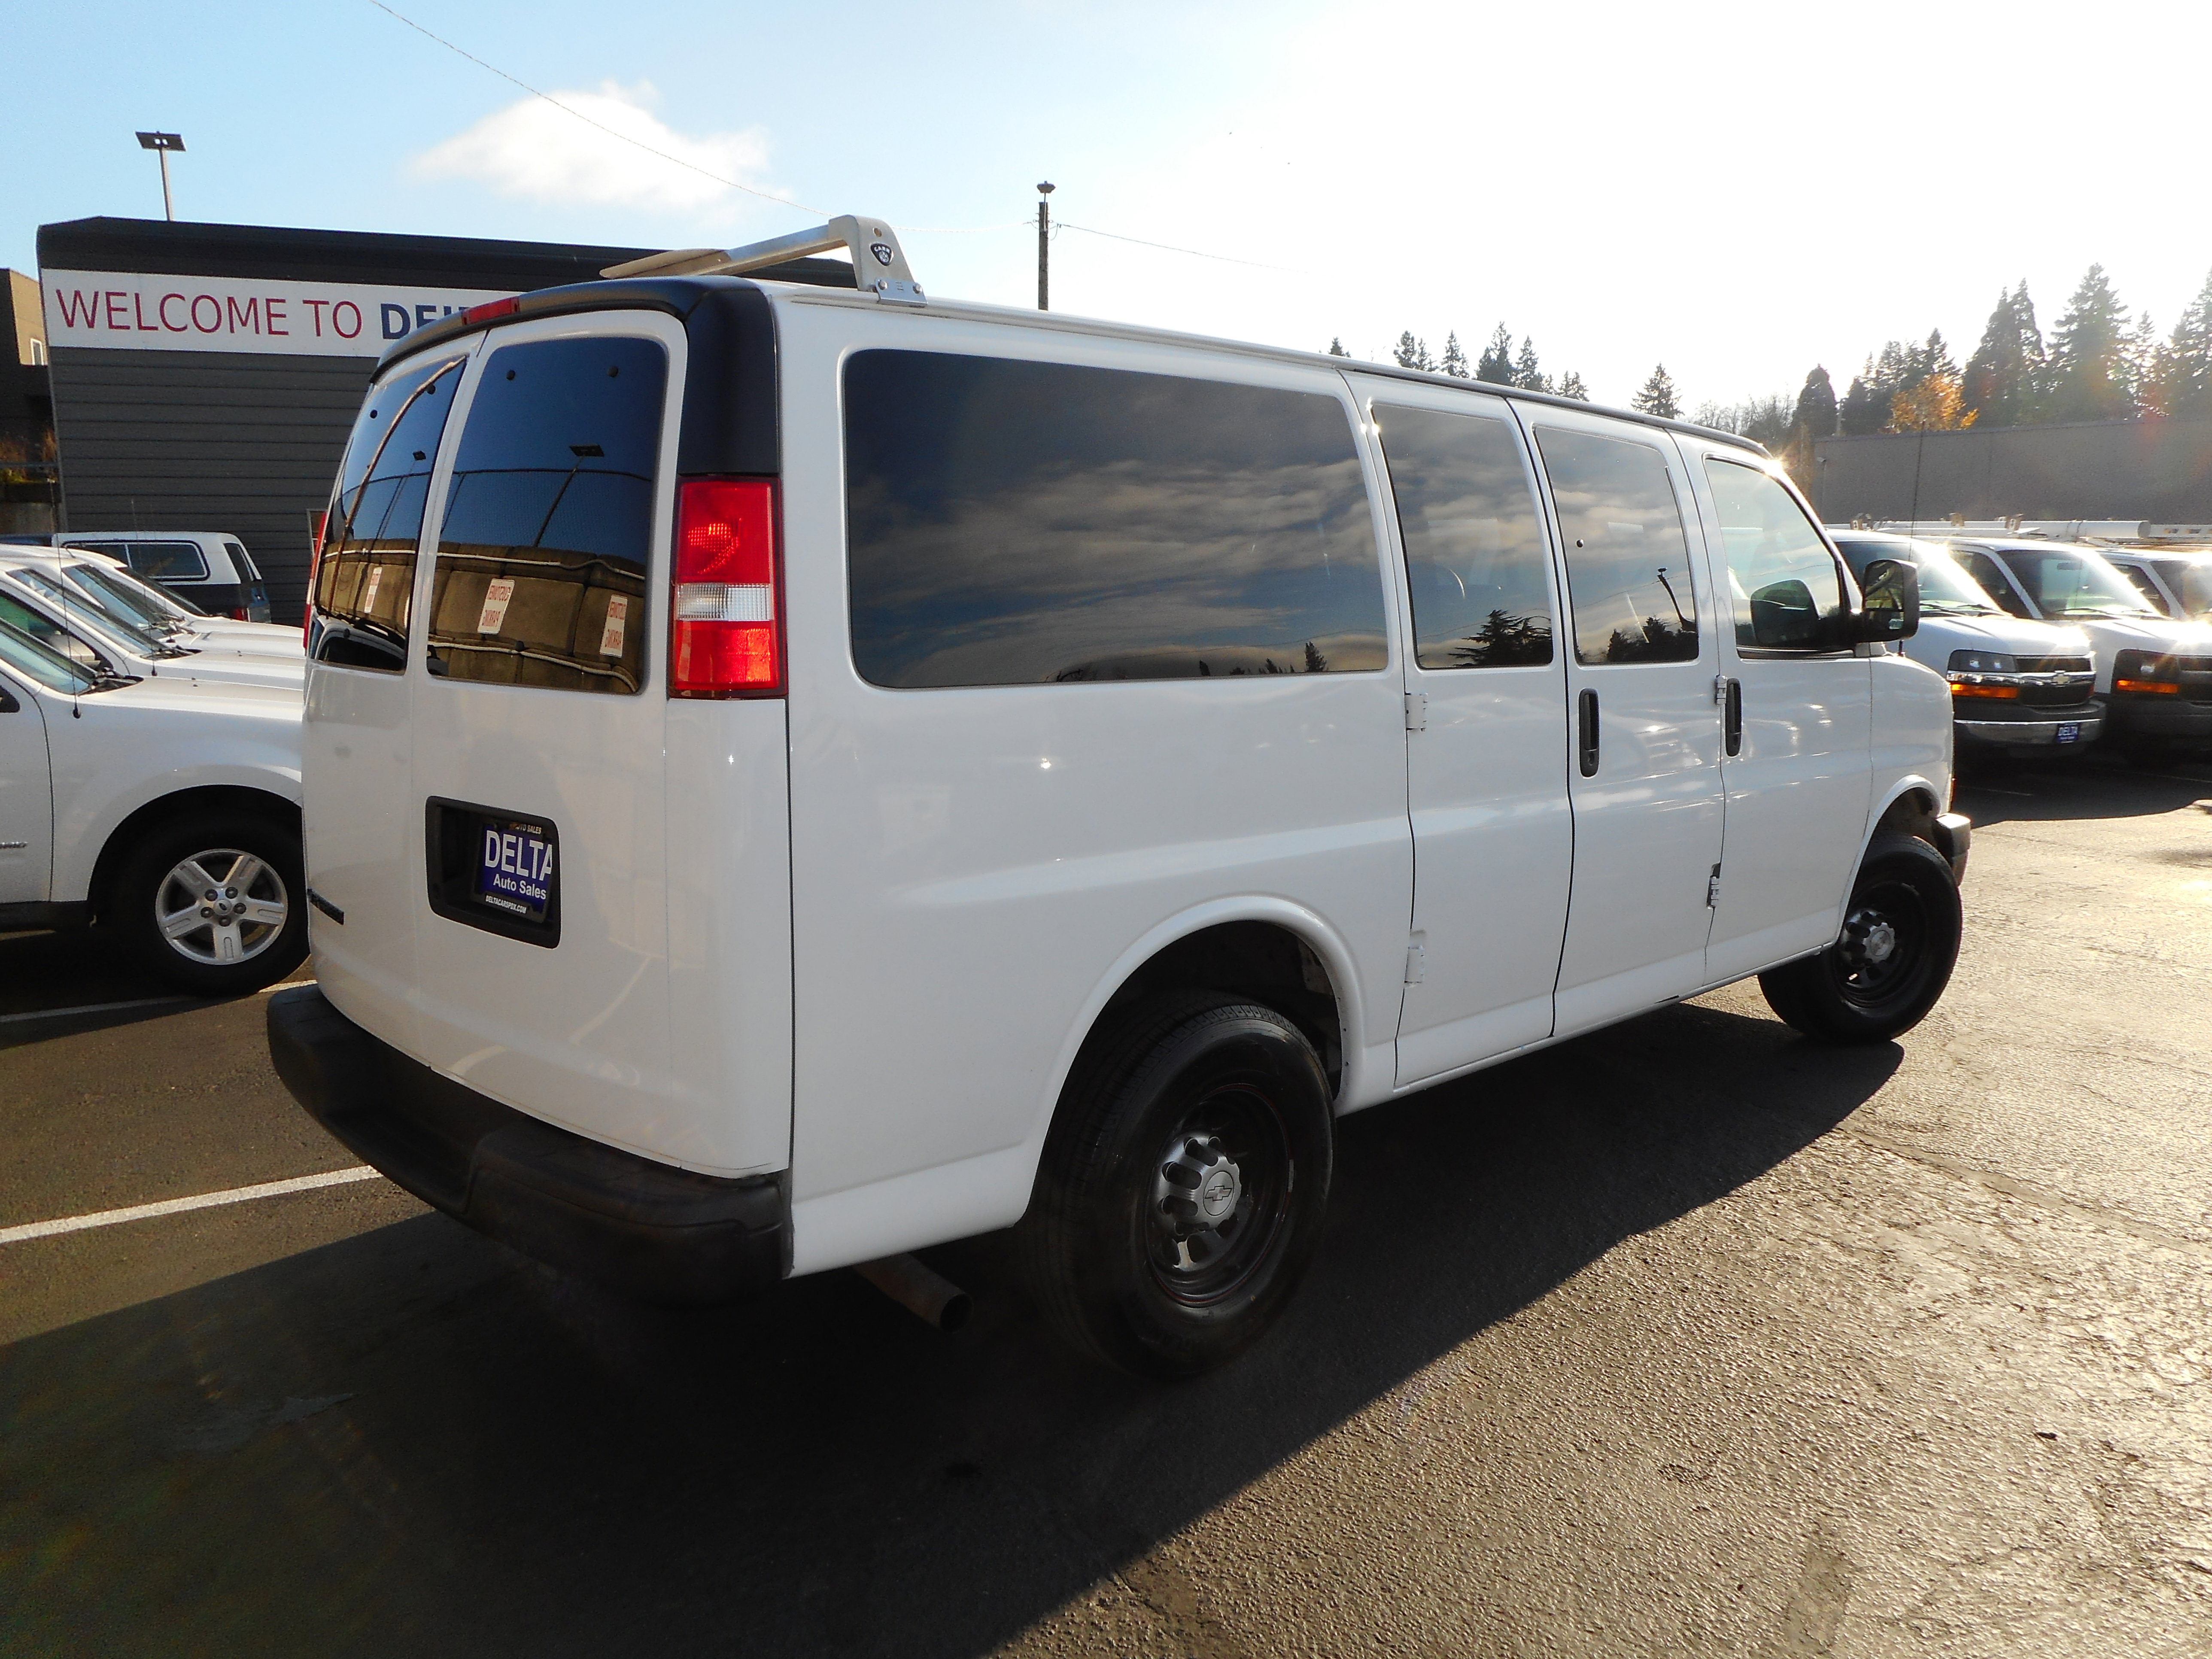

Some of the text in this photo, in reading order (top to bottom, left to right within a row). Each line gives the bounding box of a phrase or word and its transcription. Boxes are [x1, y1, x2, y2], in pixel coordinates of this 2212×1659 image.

[56, 289, 471, 339] WELCOME TO DE
[527, 825, 542, 834] SALES
[485, 830, 553, 881] DELTA
[493, 873, 546, 899] Auto Sales
